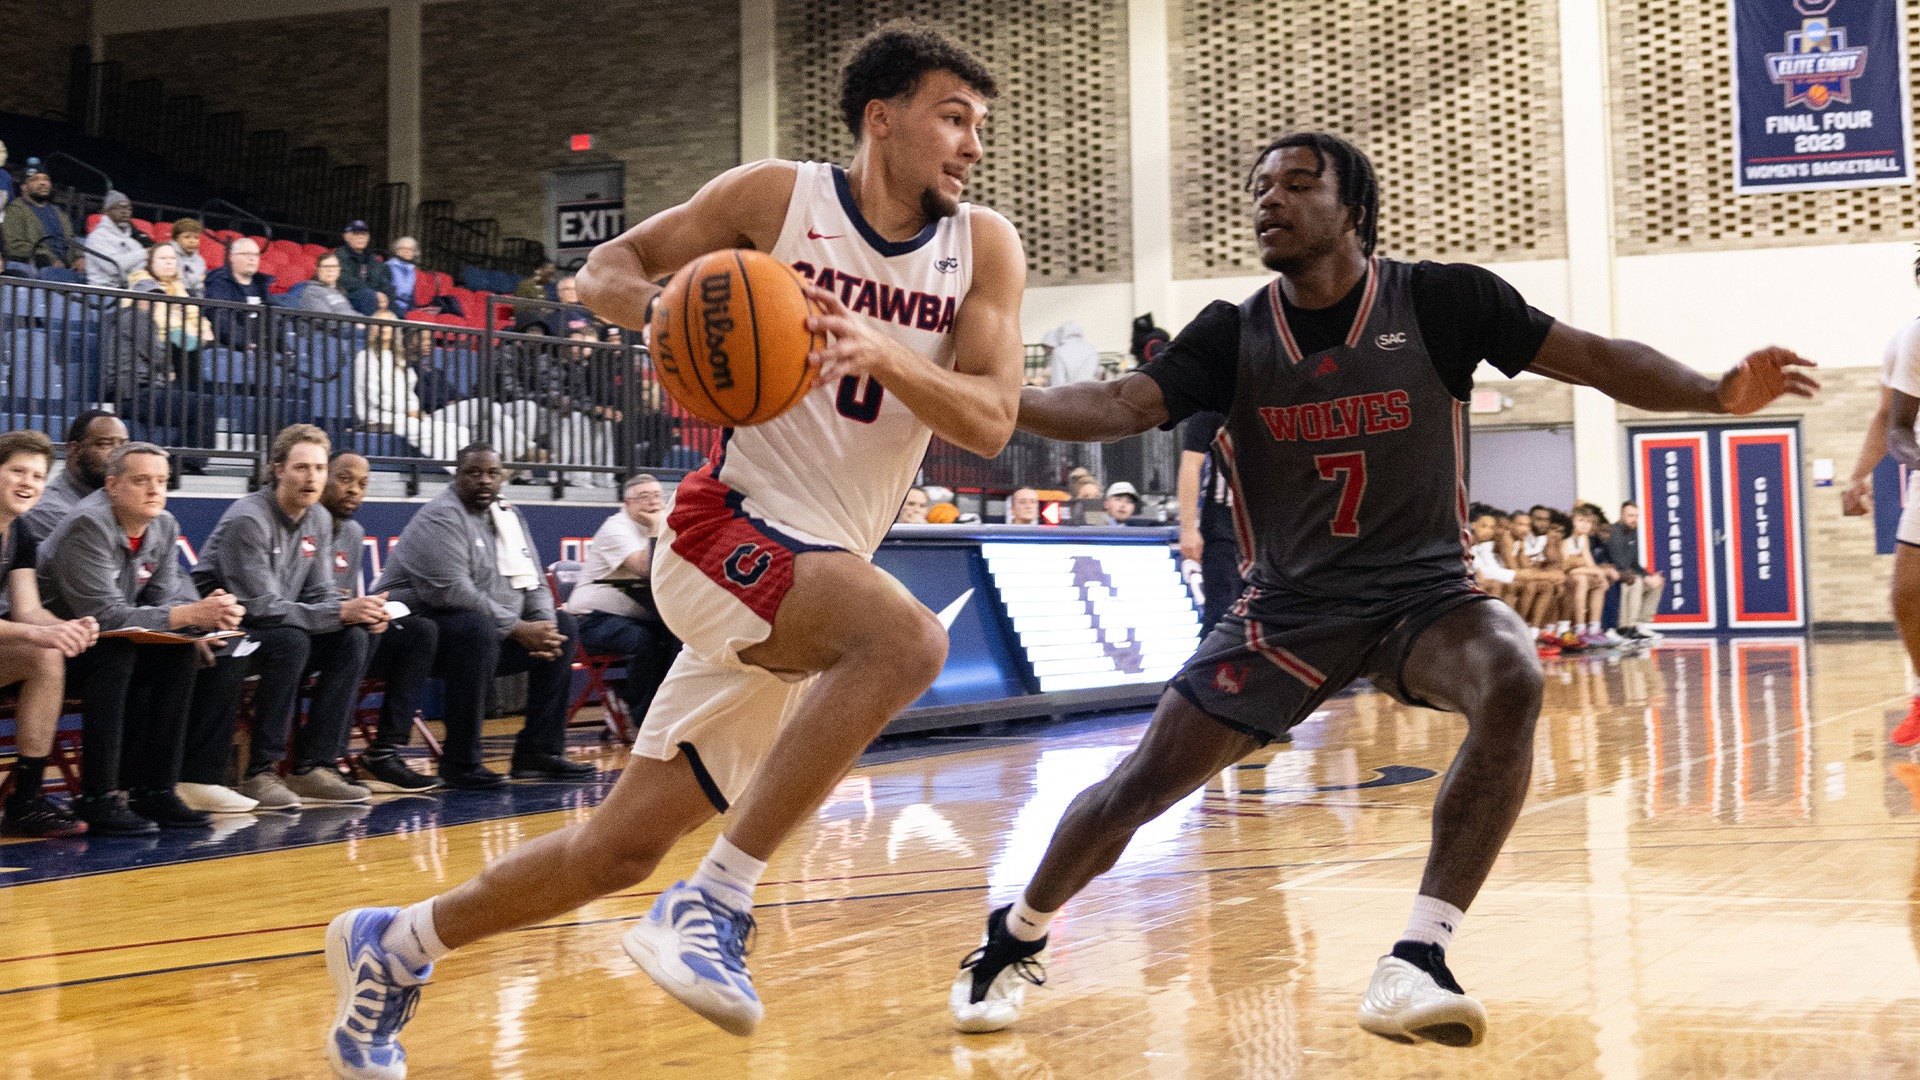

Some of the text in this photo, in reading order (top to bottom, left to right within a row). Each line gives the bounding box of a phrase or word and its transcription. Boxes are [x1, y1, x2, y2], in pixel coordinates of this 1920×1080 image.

[1778, 55, 1858, 76] ELITE EIGHT
[1766, 110, 1873, 134] FINAL FOUR
[1794, 132, 1845, 153] 2023
[1745, 158, 1900, 180] WOMEN'S BASKETBALL
[560, 208, 623, 242] EXIT
[701, 271, 734, 390] Wilson
[1379, 332, 1407, 346] SAC
[1259, 389, 1412, 441] WOLVES
[1313, 451, 1367, 537] 7
[1665, 451, 1685, 610] SCHOLARSHIP
[1754, 477, 1771, 580] CULTURE
[723, 543, 772, 589] C
